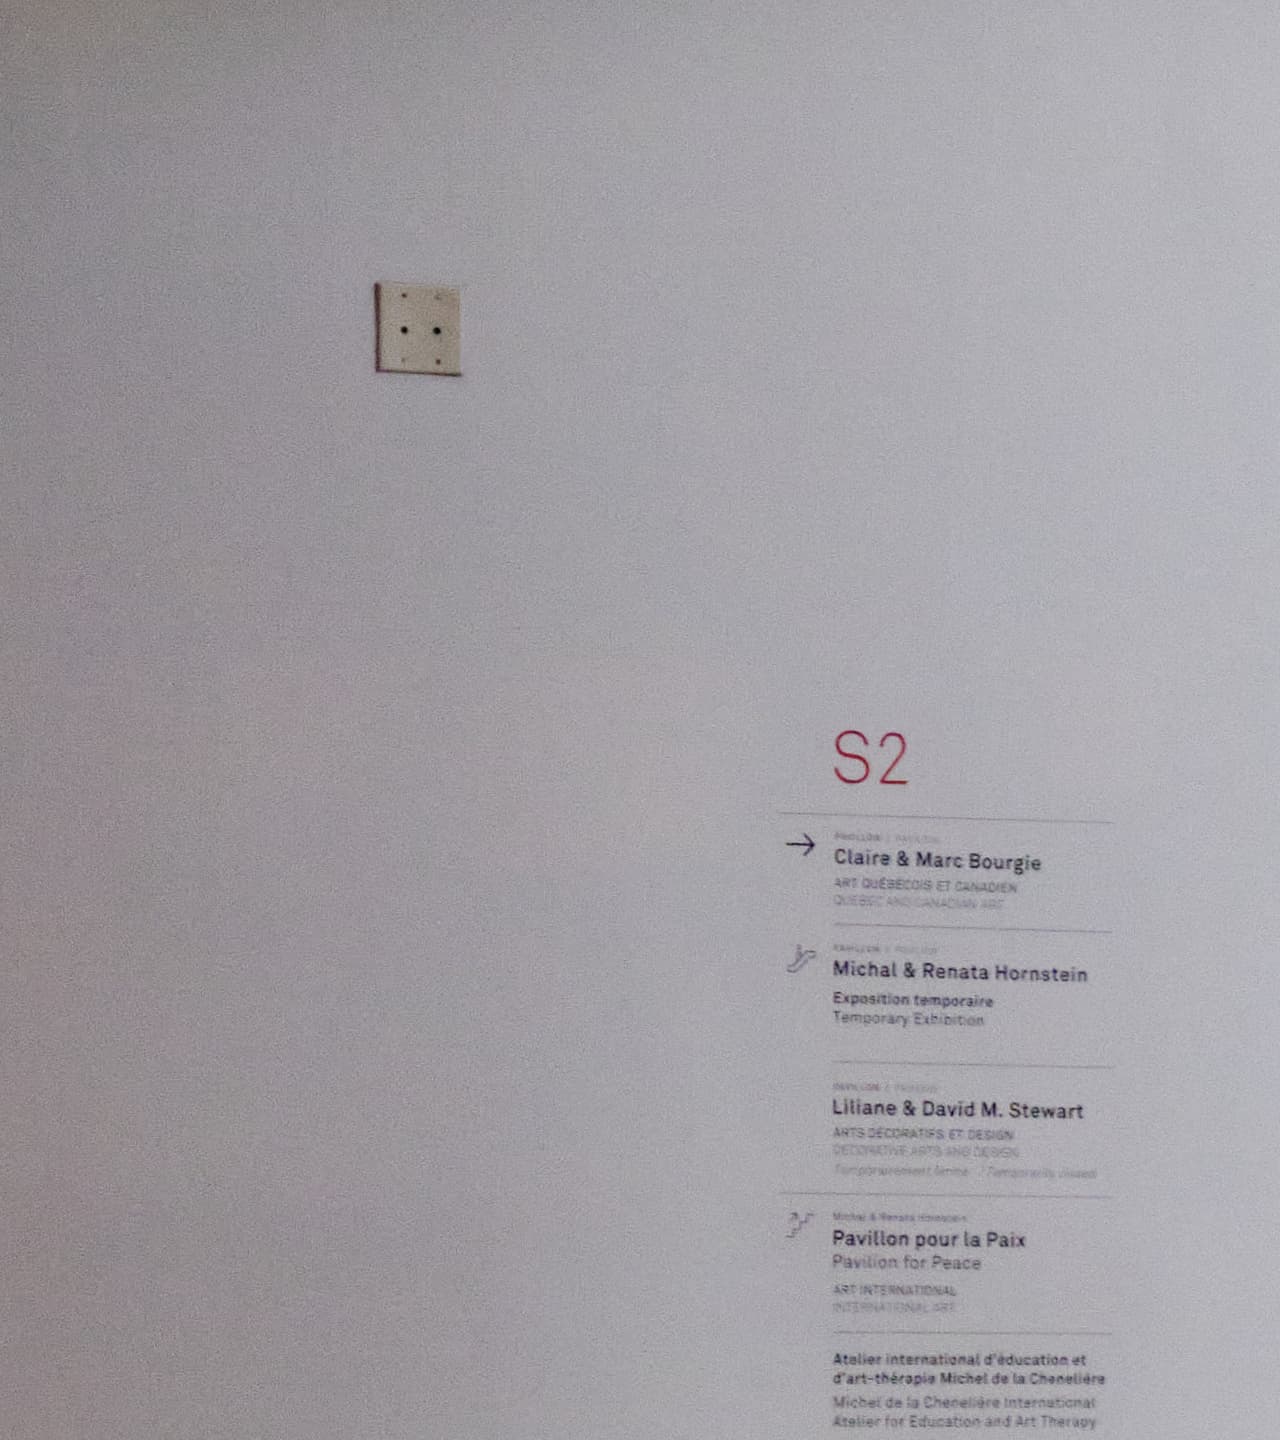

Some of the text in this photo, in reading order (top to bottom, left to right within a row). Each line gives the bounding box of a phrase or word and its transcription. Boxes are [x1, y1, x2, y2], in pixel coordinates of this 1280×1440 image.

[833, 729, 909, 785] S2
[833, 847, 1042, 876] Claire & Marc Bourgie
[833, 877, 858, 889] ART
[936, 880, 950, 891] ET
[955, 880, 1018, 893] CANADIEN
[832, 959, 1088, 983] Michal & Renata Hornstein
[832, 991, 994, 1009] Exposition temporaire
[832, 1010, 985, 1028] Temporary Exhibition
[832, 1098, 1084, 1119] Liliane & David M. Stewart
[832, 1127, 865, 1139] ARTS
[949, 1128, 964, 1140] ET
[967, 1129, 1015, 1141] DESIGN
[832, 1229, 1027, 1250] Pavillon pour la Paix
[832, 1253, 982, 1271] Pavilion for Peace
[832, 1284, 957, 1297] ART INTERNATIONAL
[832, 1353, 882, 1366] Atelier
[885, 1353, 980, 1366] international
[1071, 1354, 1087, 1367] et
[939, 1372, 989, 1385] Michel
[991, 1372, 1009, 1385] de
[1013, 1372, 1026, 1385] la
[832, 1395, 881, 1409] Michel
[885, 1395, 902, 1409] de
[906, 1396, 919, 1409] la
[1003, 1396, 1096, 1409] International
[832, 1414, 1097, 1431] Atelier for Education and Art Therapy
